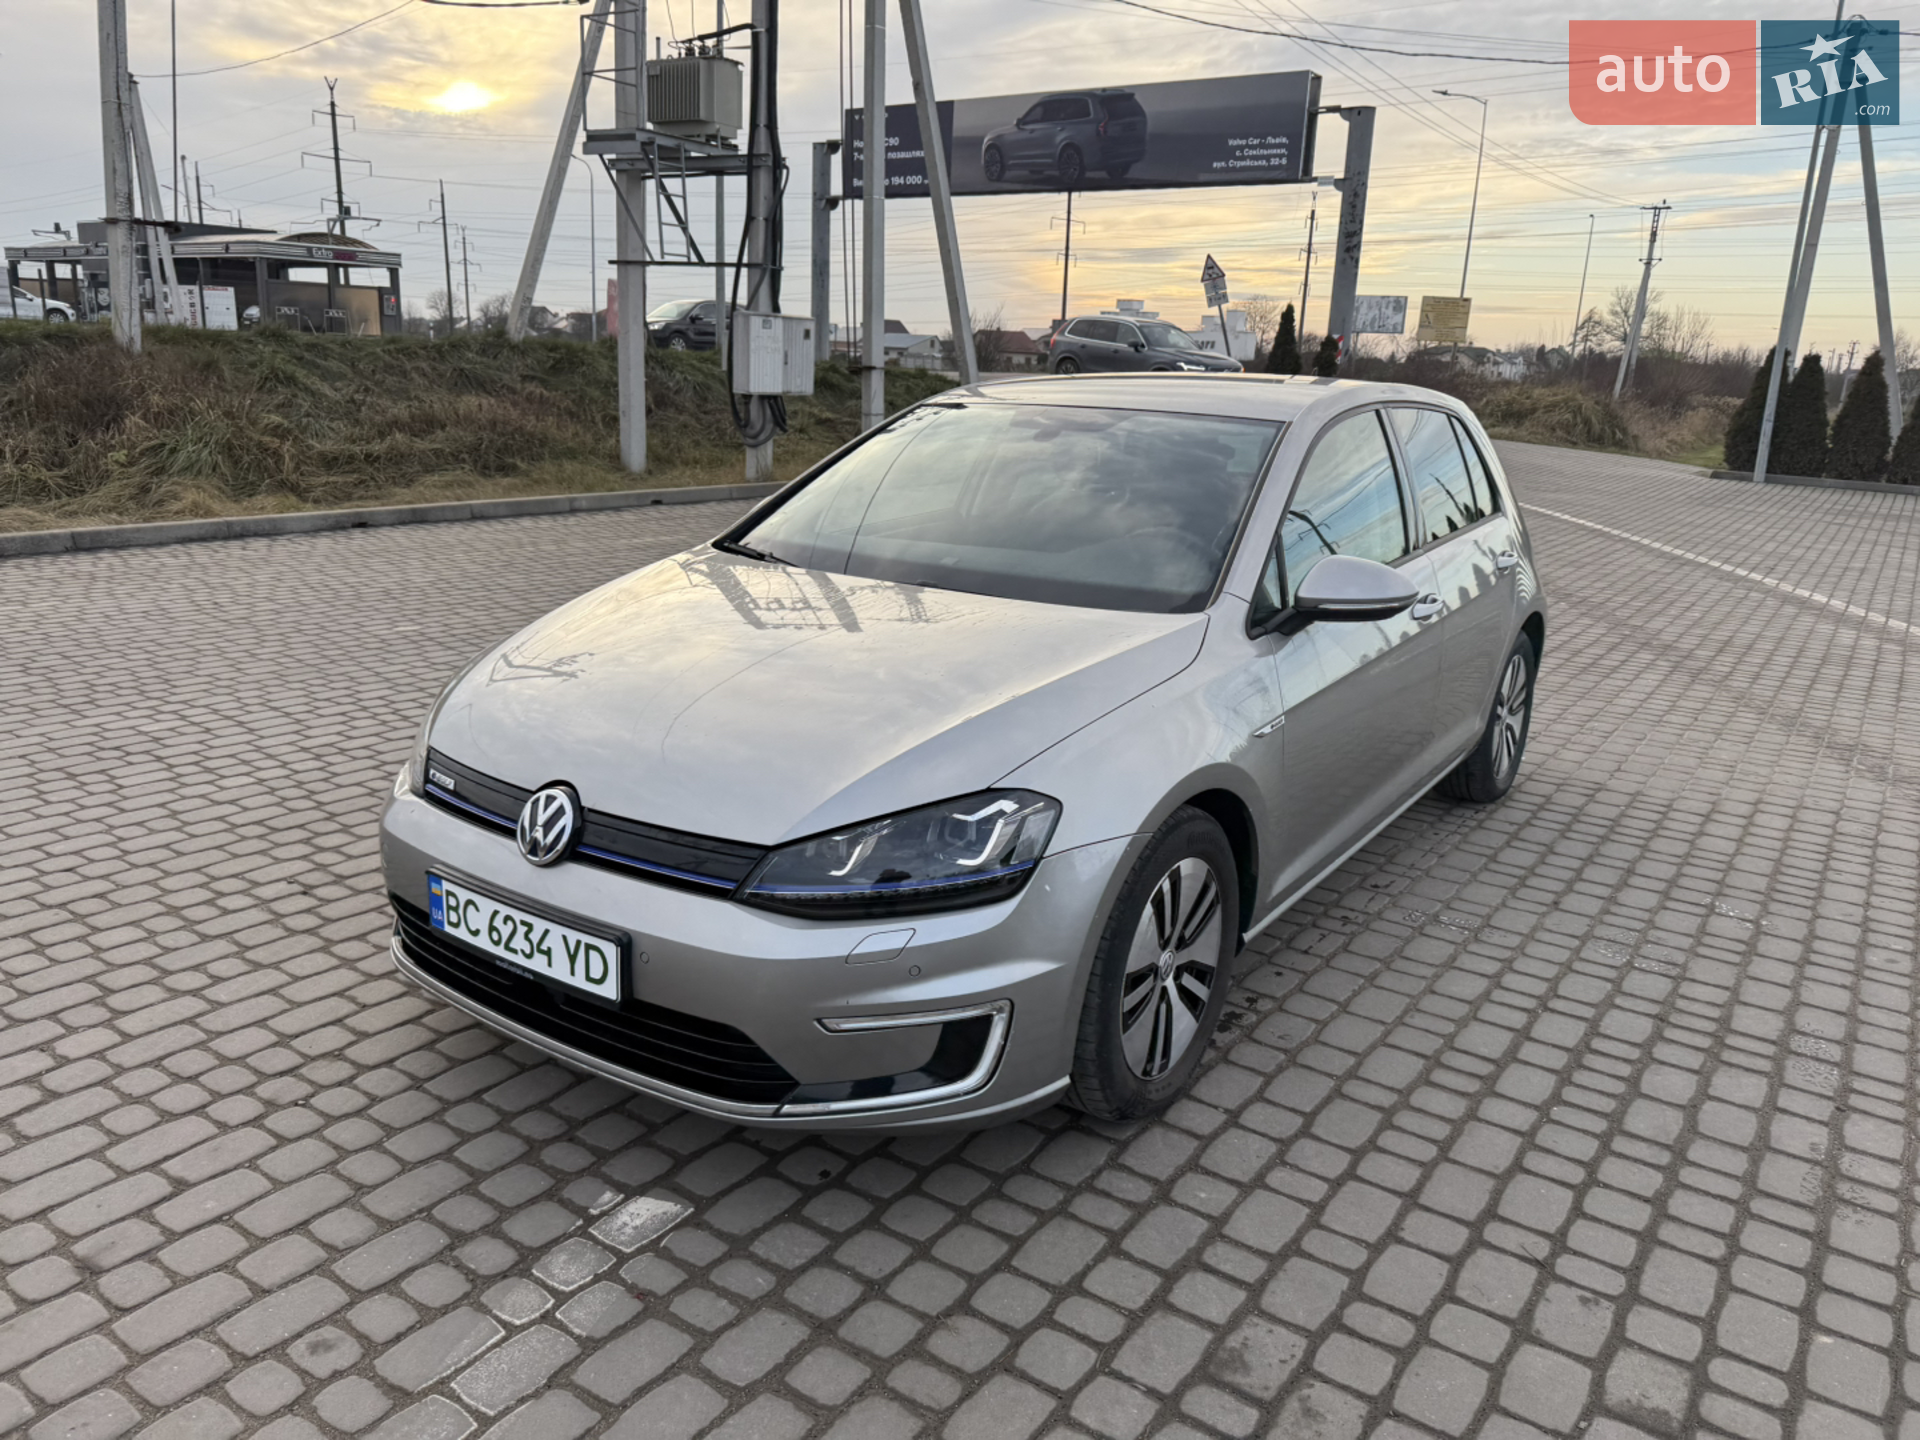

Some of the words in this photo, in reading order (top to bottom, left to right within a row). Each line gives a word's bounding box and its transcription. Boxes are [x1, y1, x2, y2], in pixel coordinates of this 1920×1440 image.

[906, 175, 923, 185] 000
[432, 906, 443, 921] UA
[445, 889, 481, 938] BC
[488, 909, 553, 968] 6234
[561, 934, 609, 986] YD
